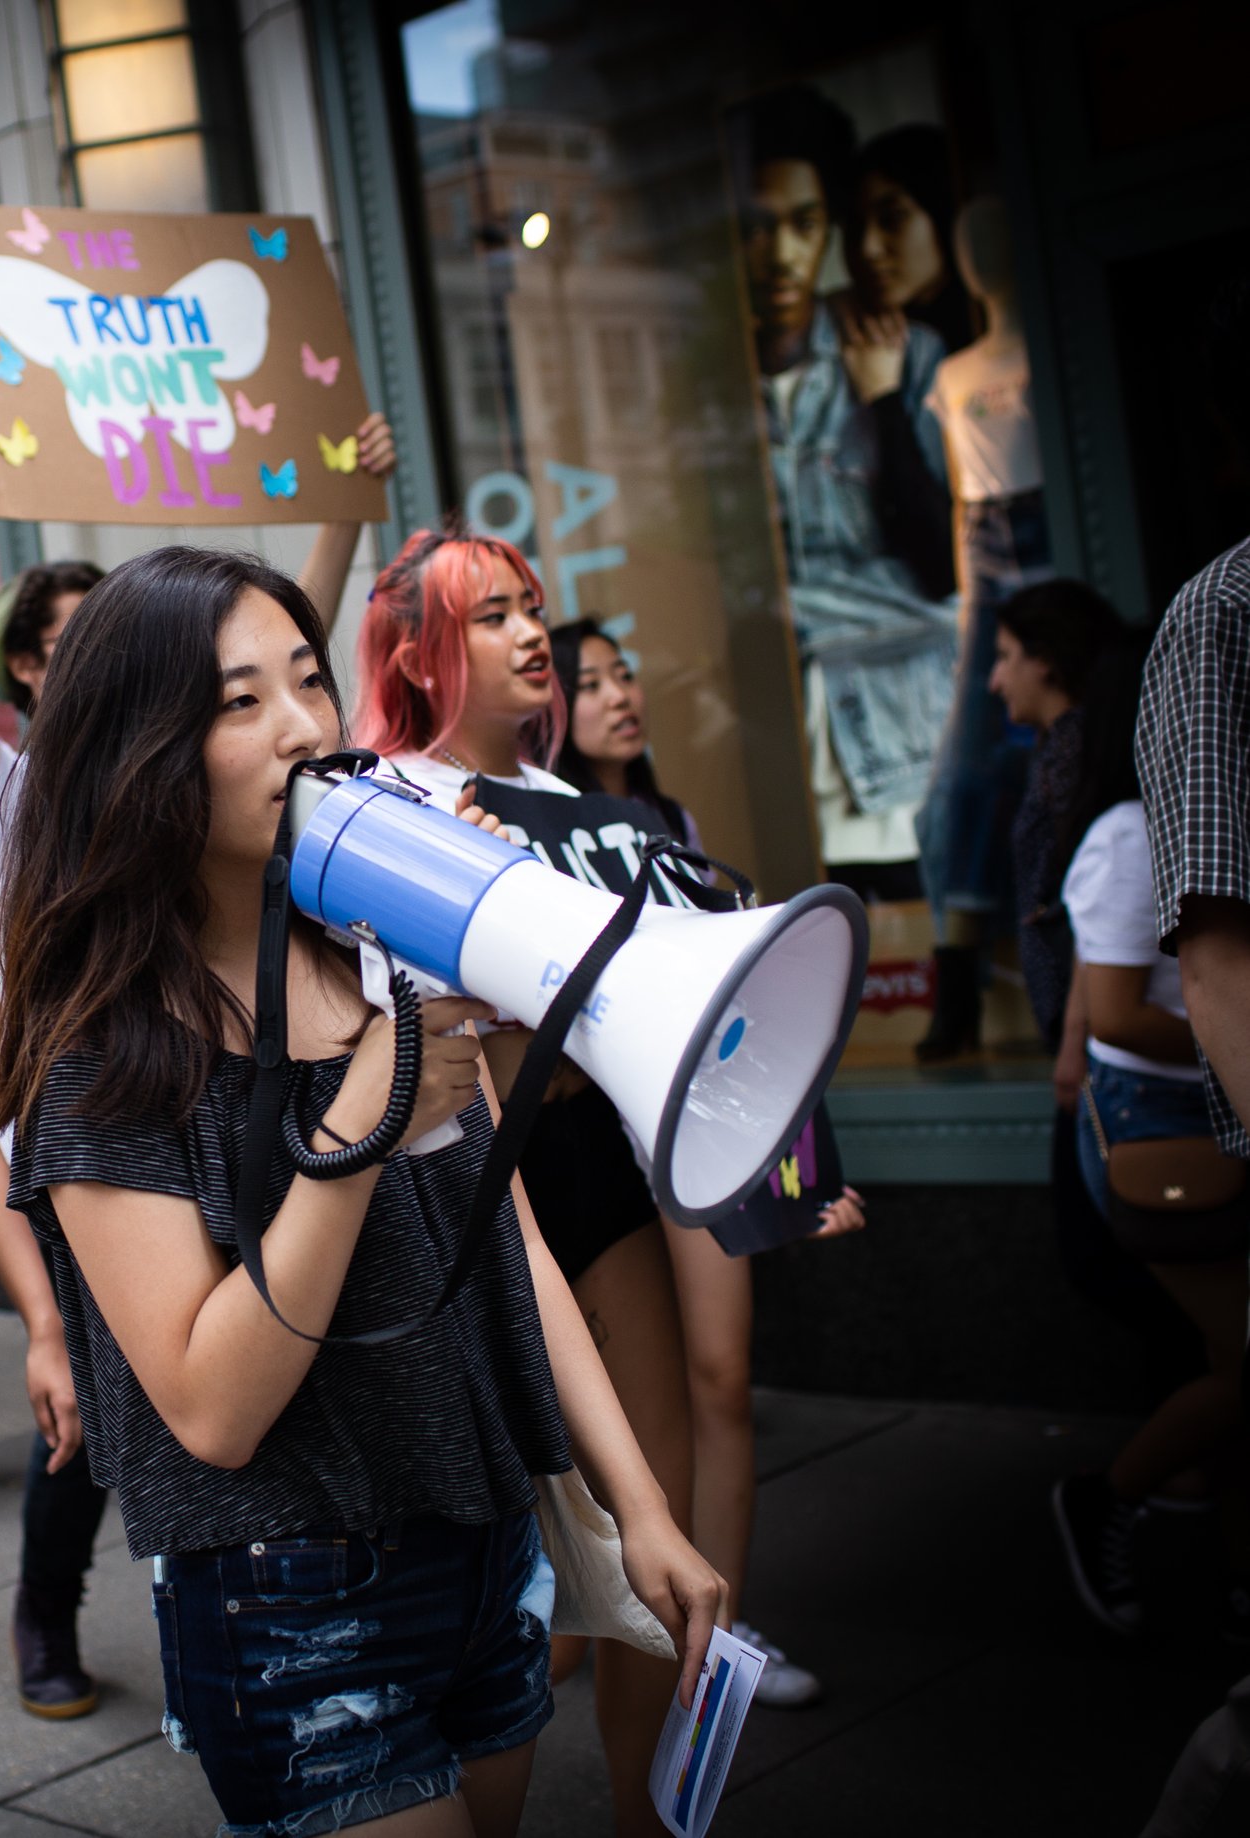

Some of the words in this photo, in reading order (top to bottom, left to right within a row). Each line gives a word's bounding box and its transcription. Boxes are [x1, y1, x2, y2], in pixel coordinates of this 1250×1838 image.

[57, 228, 141, 270] THE
[47, 293, 211, 346] TRUTH
[53, 348, 226, 408] WONT
[98, 417, 243, 507] DIE
